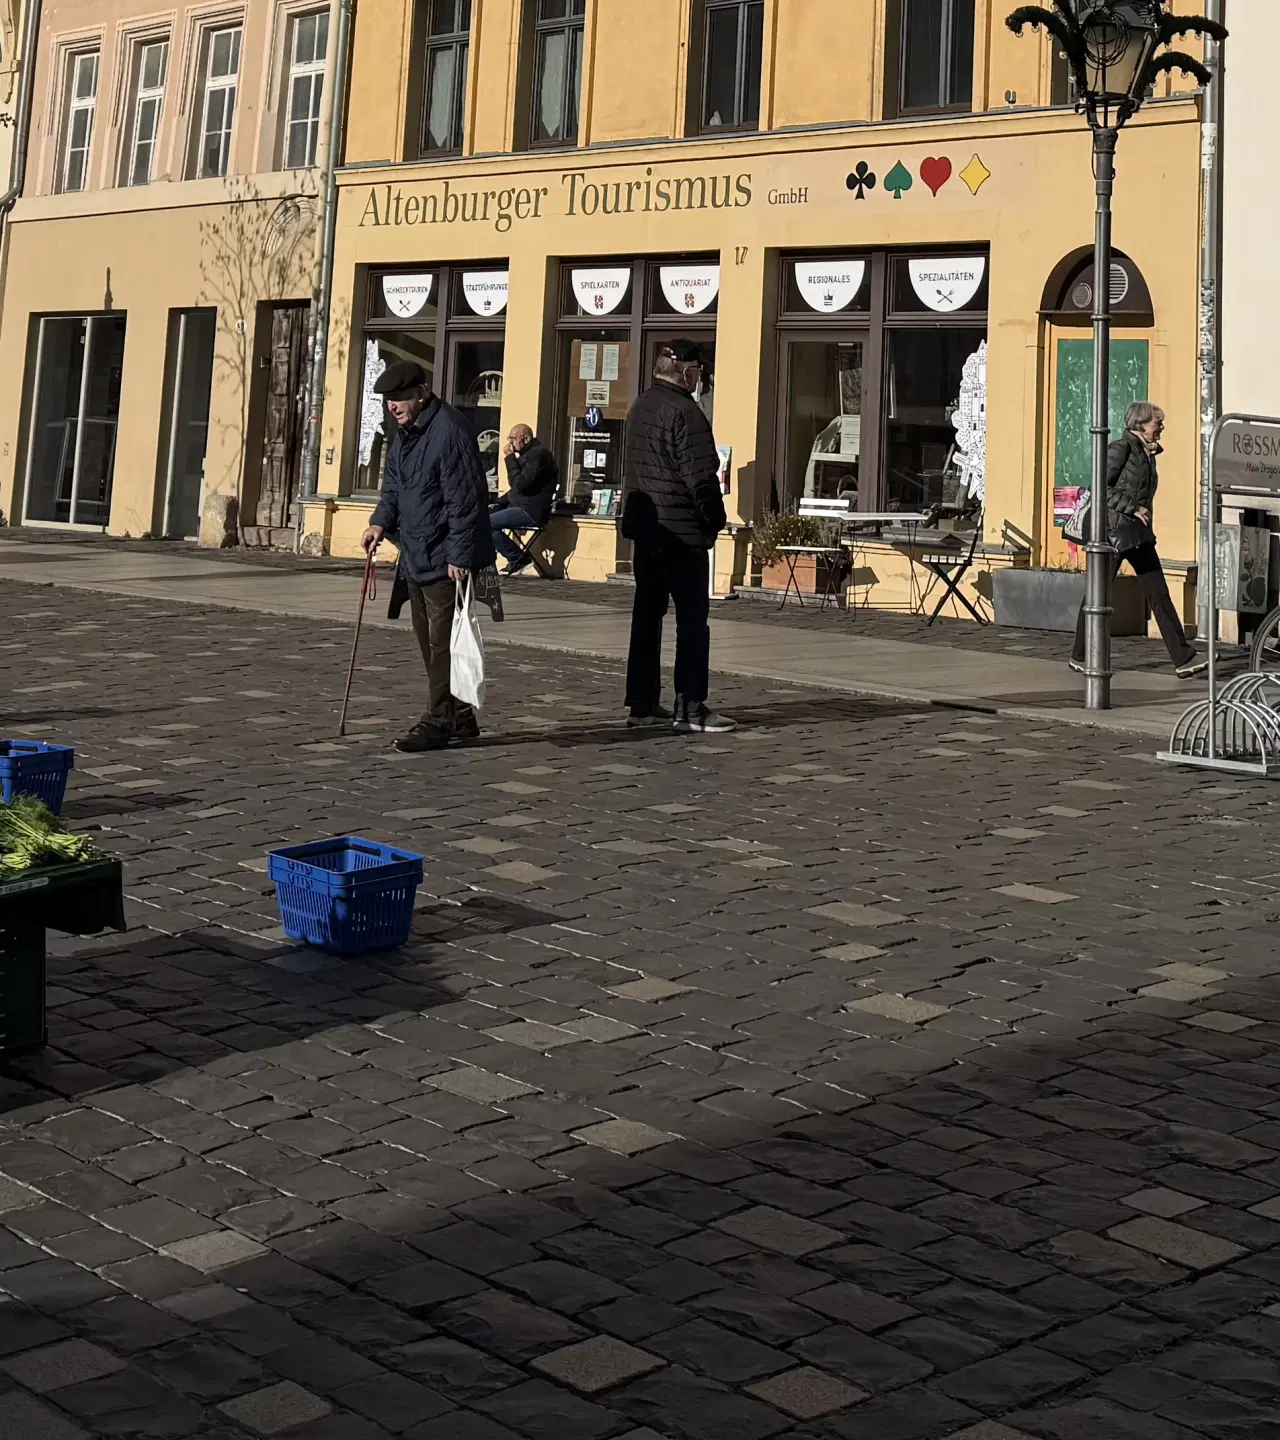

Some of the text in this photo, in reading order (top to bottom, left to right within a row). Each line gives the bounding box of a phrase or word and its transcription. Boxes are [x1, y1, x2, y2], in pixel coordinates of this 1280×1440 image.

[358, 167, 809, 233] Altenburger Tourismus GmbH
[808, 275, 851, 284] REGIONALES
[919, 271, 975, 282] SPEZIALITÄTEN
[465, 282, 508, 292] STADTFÜHRUNGE
[580, 281, 620, 290] SPIELKARTEN
[671, 279, 711, 288] ANTIQUARIAT
